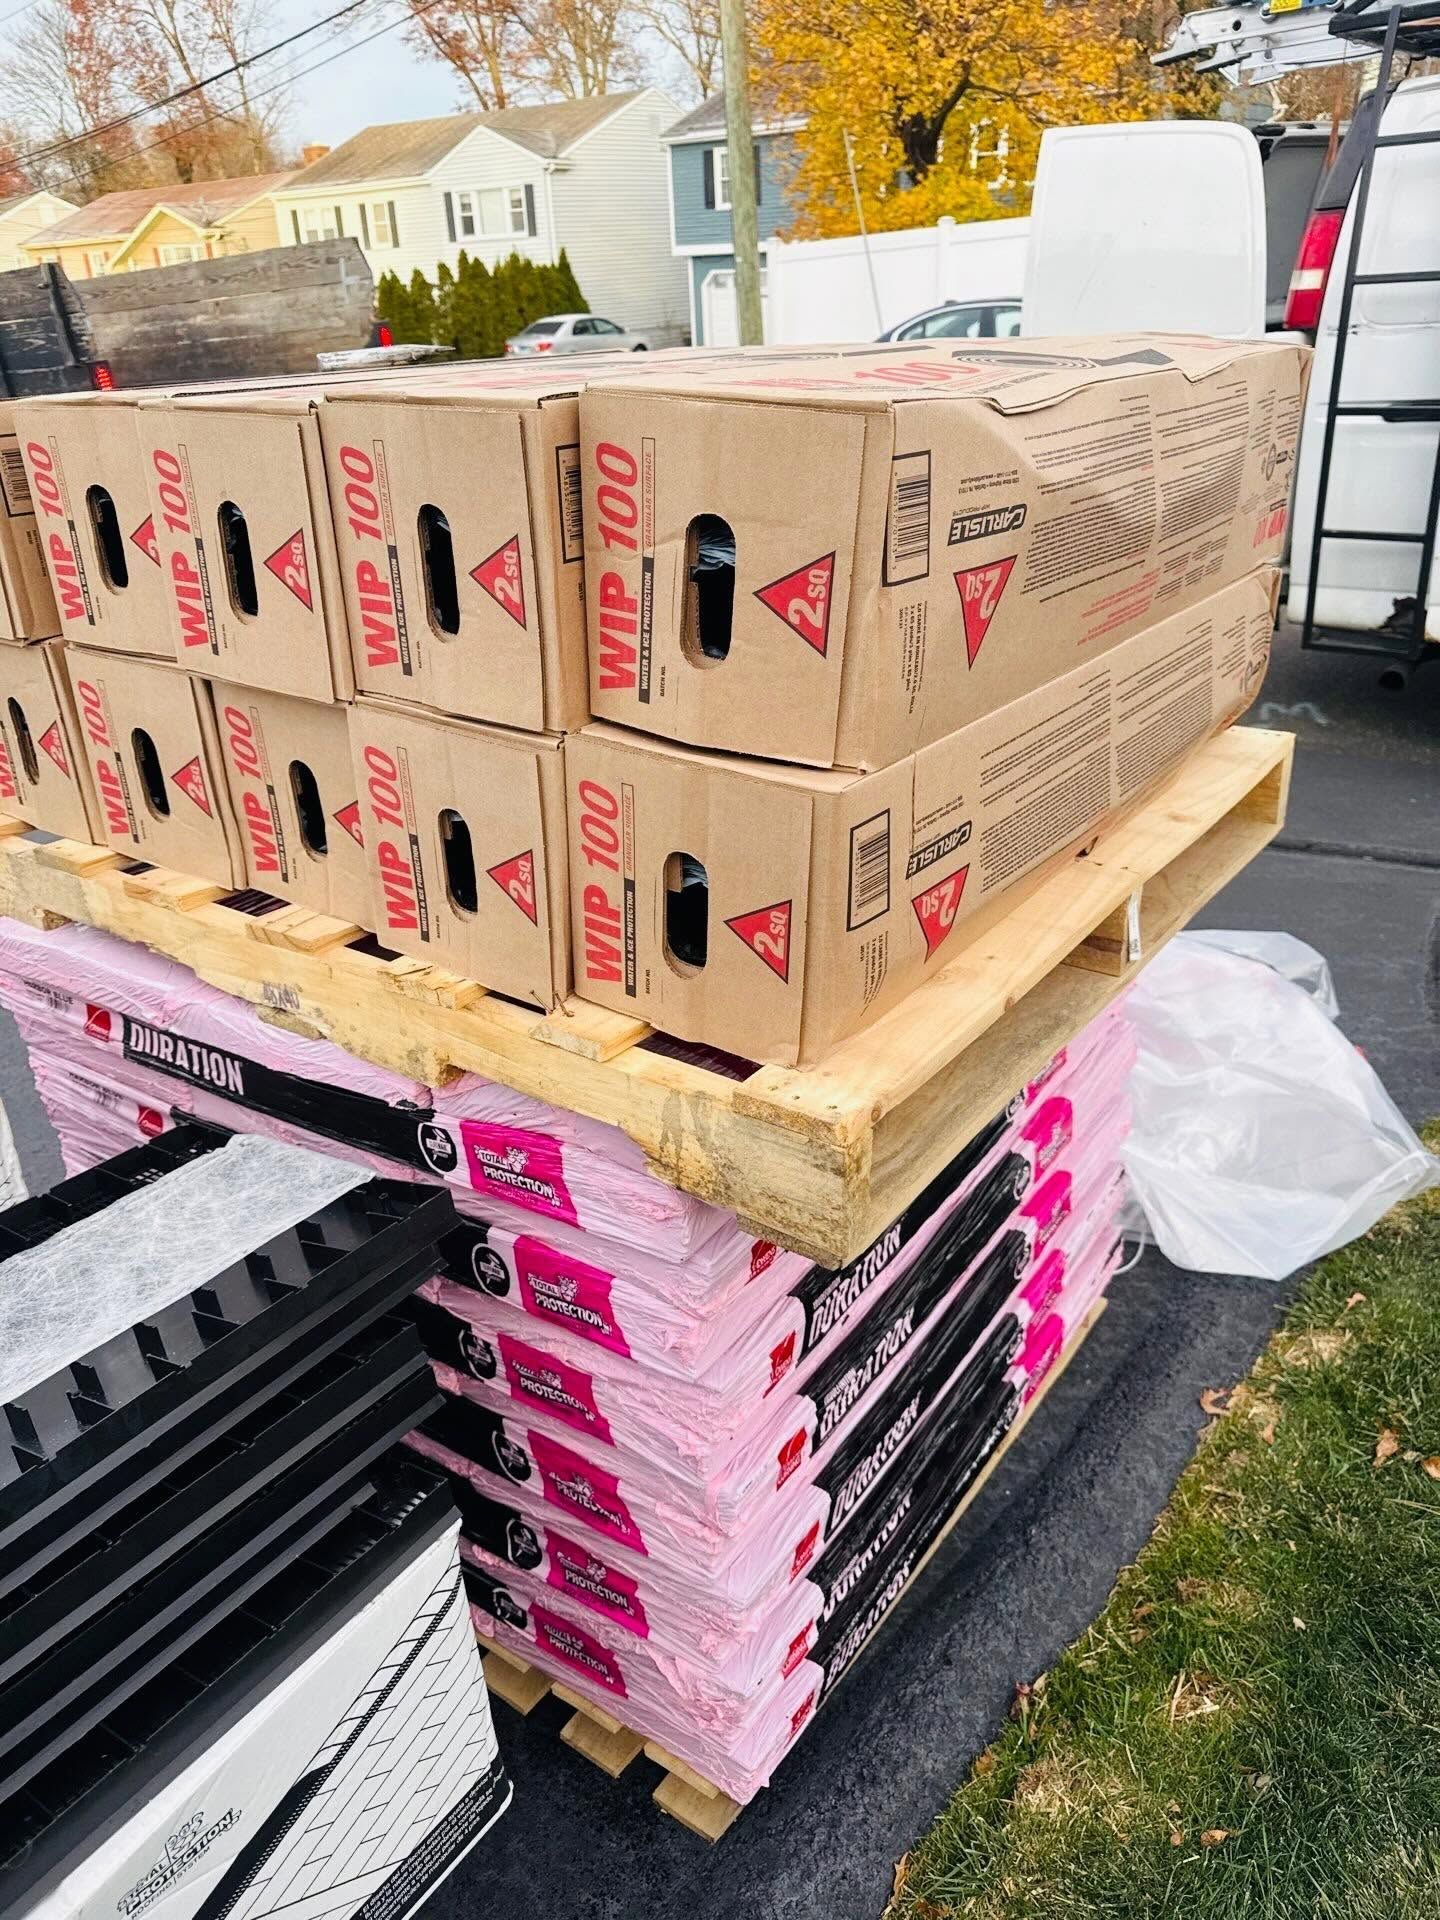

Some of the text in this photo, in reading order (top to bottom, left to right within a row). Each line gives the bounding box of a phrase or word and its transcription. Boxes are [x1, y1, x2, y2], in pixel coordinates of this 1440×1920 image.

[27, 442, 64, 518] 100
[153, 449, 209, 647] WIP 100
[952, 506, 1025, 541] CARLISLE
[50, 533, 86, 620] WIP
[340, 446, 399, 668] WIP 100
[390, 558, 403, 610] PROTECTION
[595, 442, 638, 690] WIP 100
[397, 612, 405, 626] ICE
[643, 572, 651, 630] PROTECTION
[400, 636, 410, 664] WATER
[642, 633, 650, 647] ICE
[641, 659, 649, 689] WATER
[78, 680, 111, 748] 100
[224, 706, 262, 780] 100
[96, 760, 130, 834] WIP
[242, 791, 280, 872] WIP
[364, 745, 419, 930] WIP 100
[909, 825, 970, 874] CARLISLE
[412, 844, 423, 888] PROTECTION
[578, 780, 623, 982] WIP 100
[420, 908, 428, 932] WATER
[129, 1020, 245, 1096] DURATION
[481, 1151, 505, 1166] TOTAL
[483, 1166, 552, 1197] PROTECTION
[536, 1293, 602, 1327] PROTECTION
[808, 1223, 901, 1348] DURATION
[820, 1305, 915, 1440] DURATION
[565, 1570, 628, 1608] PROTECTION
[549, 1638, 609, 1675] PROTECTION
[127, 1808, 233, 1915] PROTECTION
[176, 1846, 211, 1879] SYSTEM
